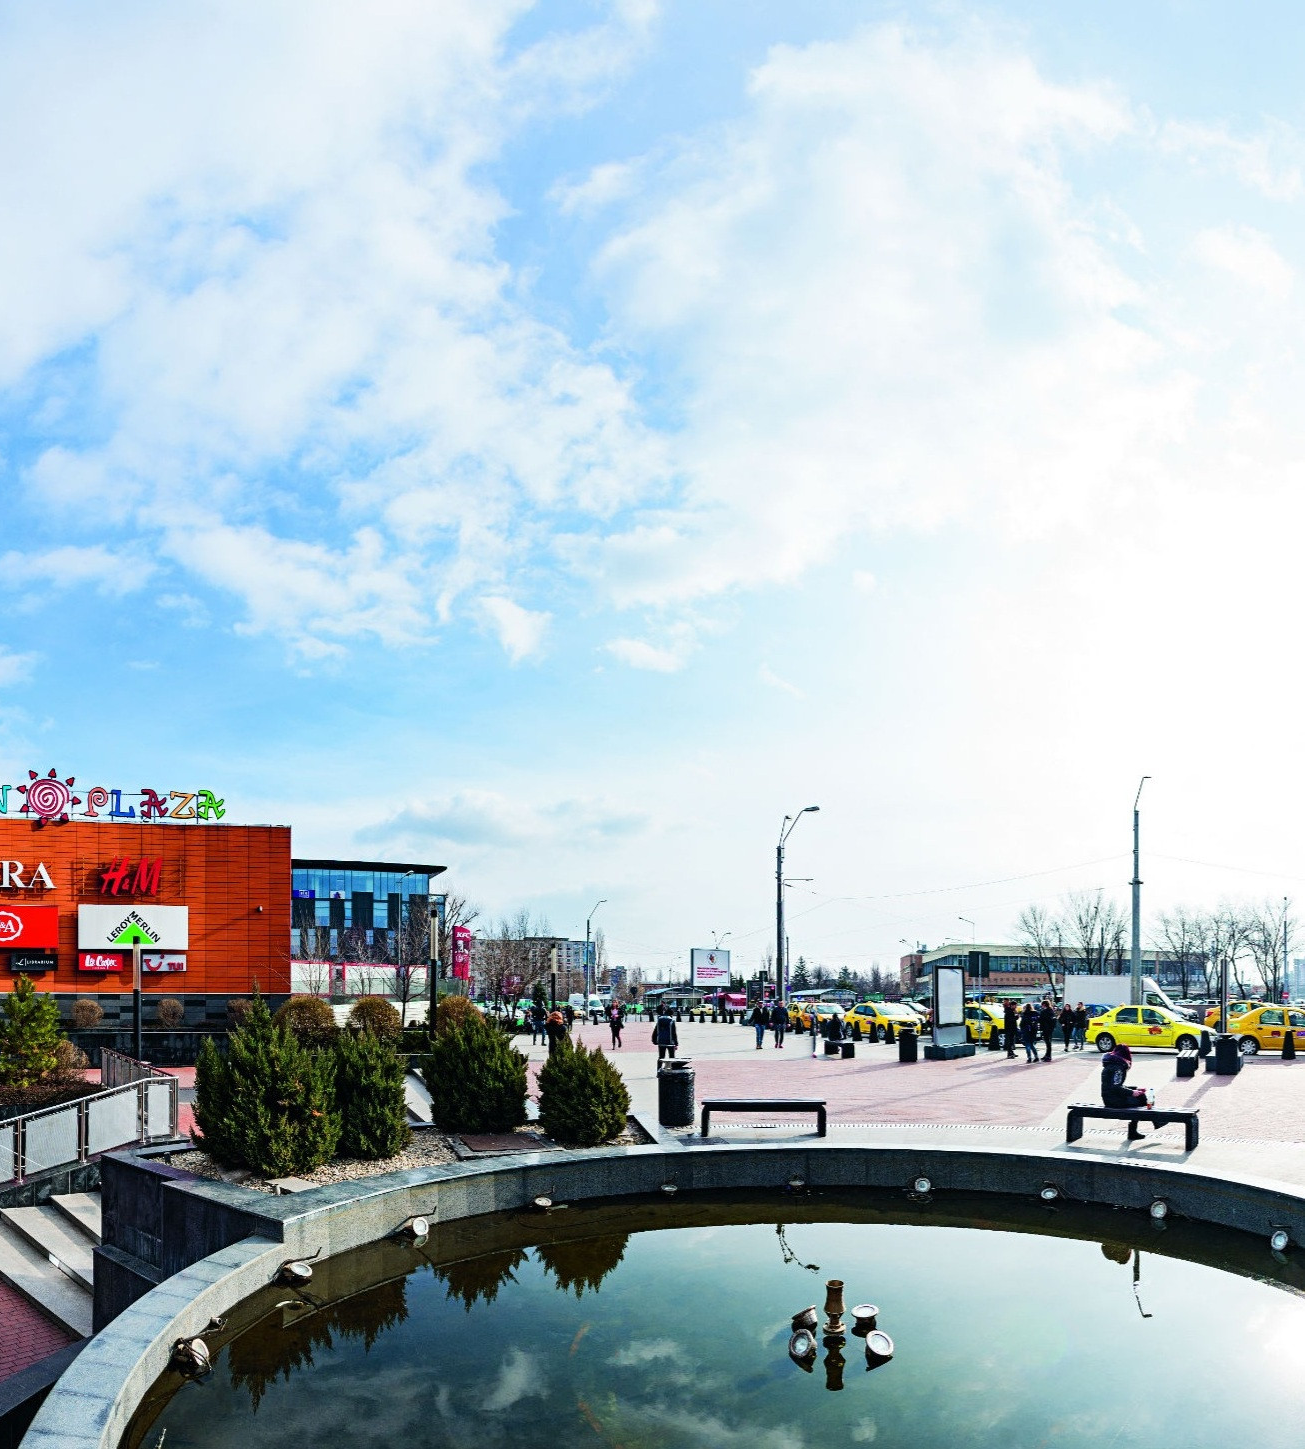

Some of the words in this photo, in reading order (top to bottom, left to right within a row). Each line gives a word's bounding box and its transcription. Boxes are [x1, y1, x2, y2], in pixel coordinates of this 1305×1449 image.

[85, 786, 225, 820] PLAZA
[101, 856, 163, 895] H&M
[106, 916, 132, 942] LEROY
[129, 911, 161, 943] MERLIN
[167, 962, 184, 970] TUI
